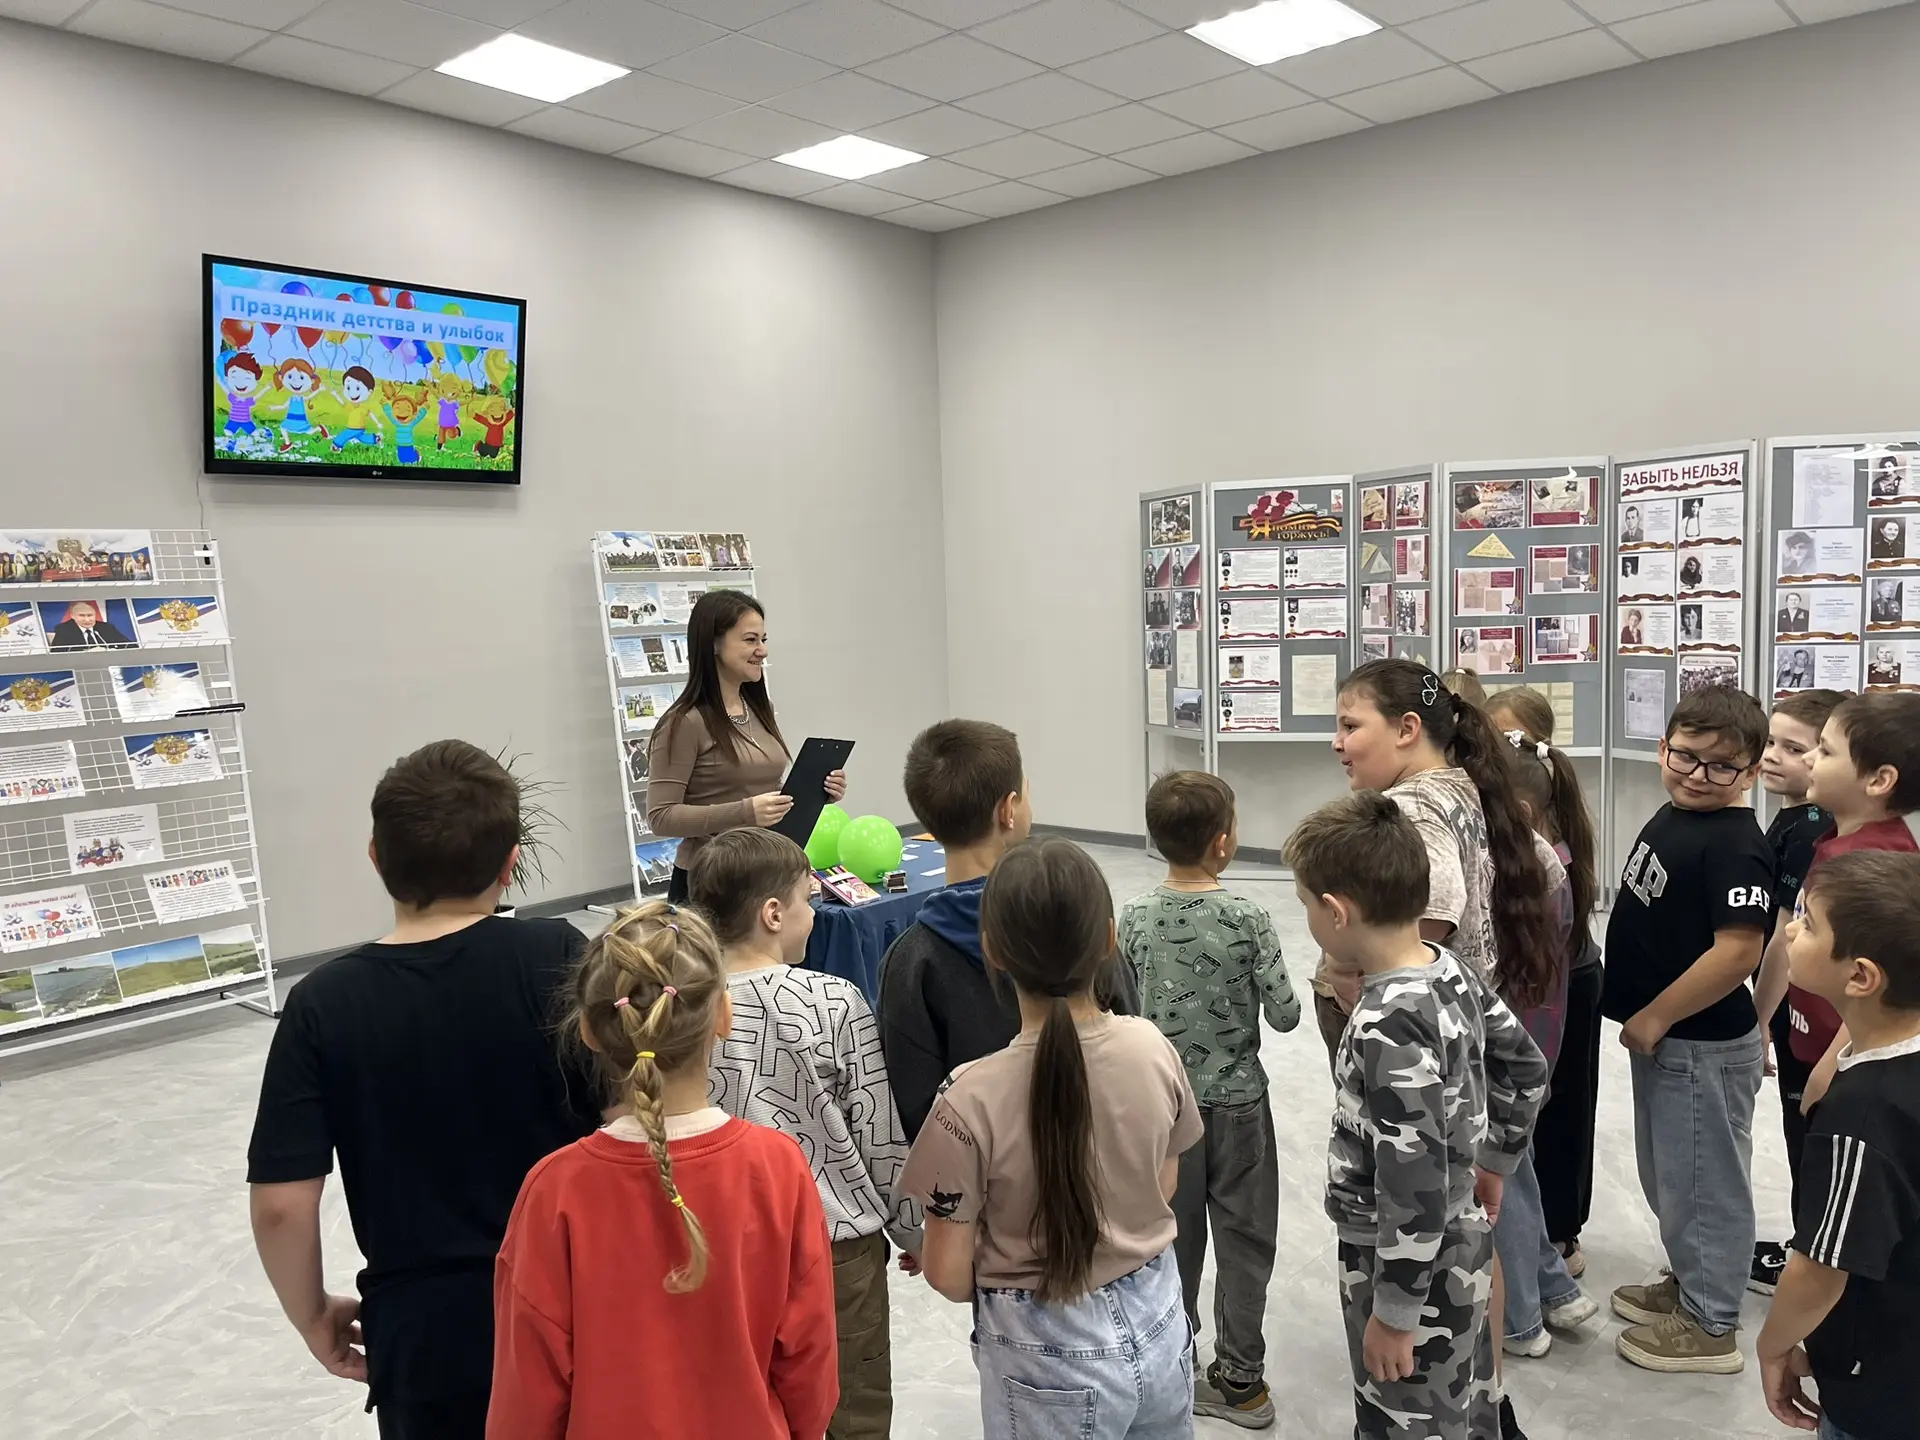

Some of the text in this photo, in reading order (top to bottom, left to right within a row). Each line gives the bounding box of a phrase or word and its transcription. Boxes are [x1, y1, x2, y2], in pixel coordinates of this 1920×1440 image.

[231, 296, 505, 343] Праздник детства и улыбок
[1622, 462, 1738, 486] ЗАБЫТЬ НЕЛЬЗЯ
[1250, 515, 1271, 541] Я
[1623, 841, 1668, 907] AP
[1728, 886, 1770, 913] GAP
